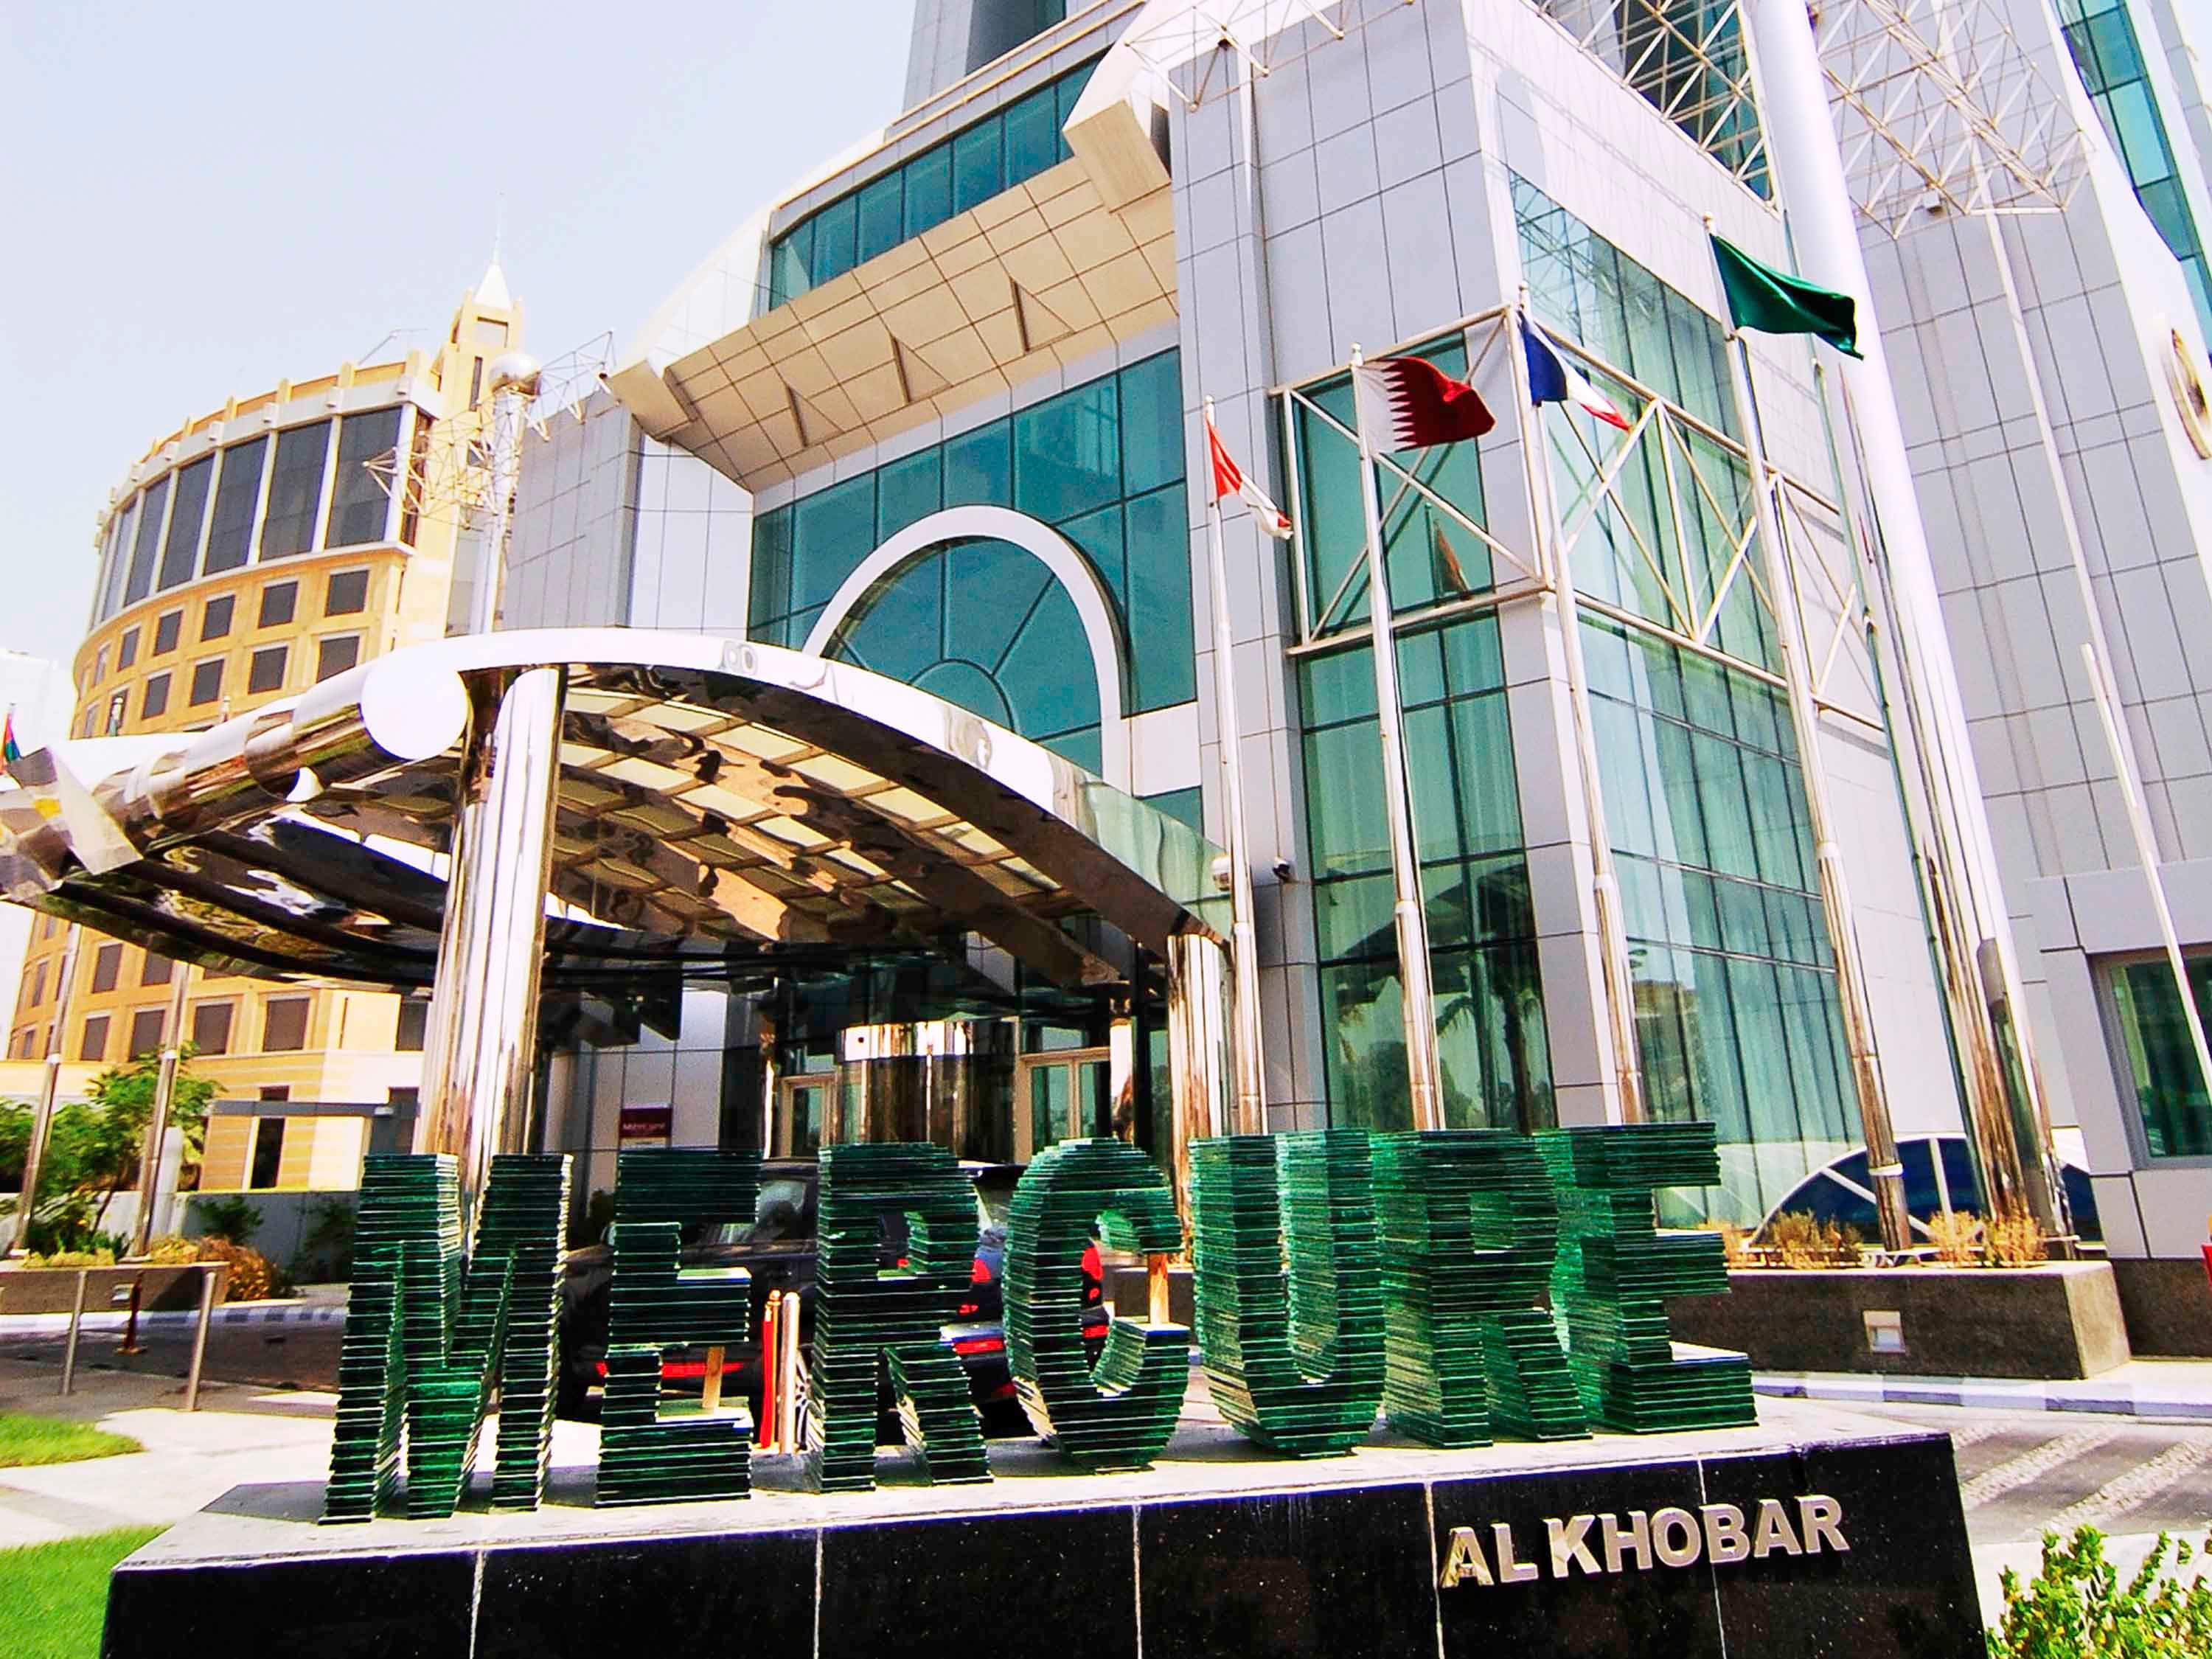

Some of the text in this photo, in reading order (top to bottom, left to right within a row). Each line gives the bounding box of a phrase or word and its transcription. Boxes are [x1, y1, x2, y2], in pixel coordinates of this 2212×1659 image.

[317, 1122, 1759, 1523] MERCURE
[1440, 1494, 1850, 1588] AL KHOBAR
